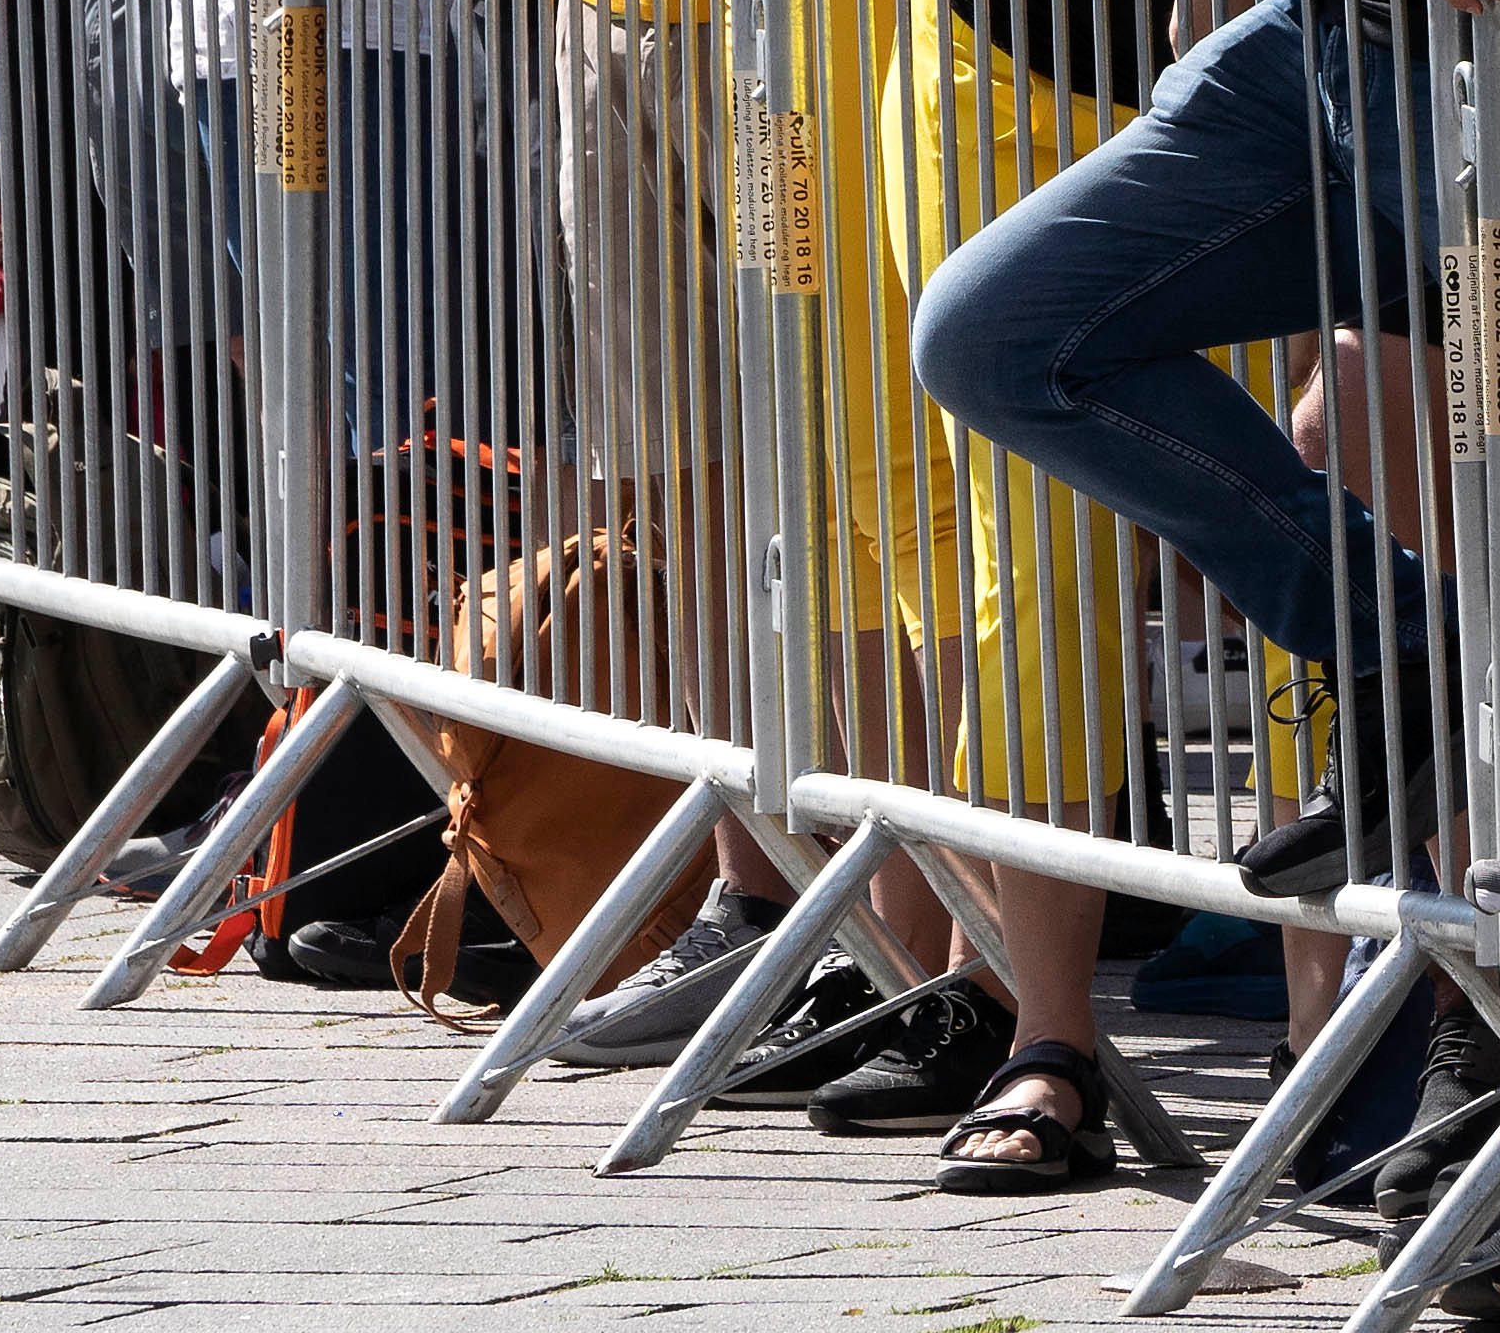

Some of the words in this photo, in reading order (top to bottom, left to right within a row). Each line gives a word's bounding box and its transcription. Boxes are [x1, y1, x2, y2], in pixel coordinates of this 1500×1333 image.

[284, 86, 294, 107] 70
[314, 86, 327, 106] 70
[743, 78, 751, 122] Udlejning
[284, 112, 295, 133] 20
[315, 112, 327, 132] 20
[746, 124, 753, 134] af
[285, 139, 295, 158] 18
[315, 139, 327, 158] 18
[746, 137, 755, 180] toiletter,
[778, 150, 786, 160] af
[285, 164, 296, 184] 16
[316, 164, 327, 184] 16
[778, 161, 788, 204] toiletter,
[792, 179, 808, 201] 70
[747, 183, 756, 221] moduler
[780, 207, 789, 247] moduler
[794, 207, 810, 230] 20
[748, 224, 756, 236] og
[749, 238, 758, 261] hegn
[796, 235, 811, 257] 18
[797, 263, 812, 286] 16
[1467, 254, 1477, 301] Udlejning
[1471, 304, 1479, 315] af
[1448, 338, 1463, 363] 70
[1471, 318, 1482, 365] toiletter,
[1450, 369, 1465, 393] 20
[1452, 401, 1467, 424] 18
[1474, 412, 1483, 425] og
[1454, 431, 1469, 454] 16
